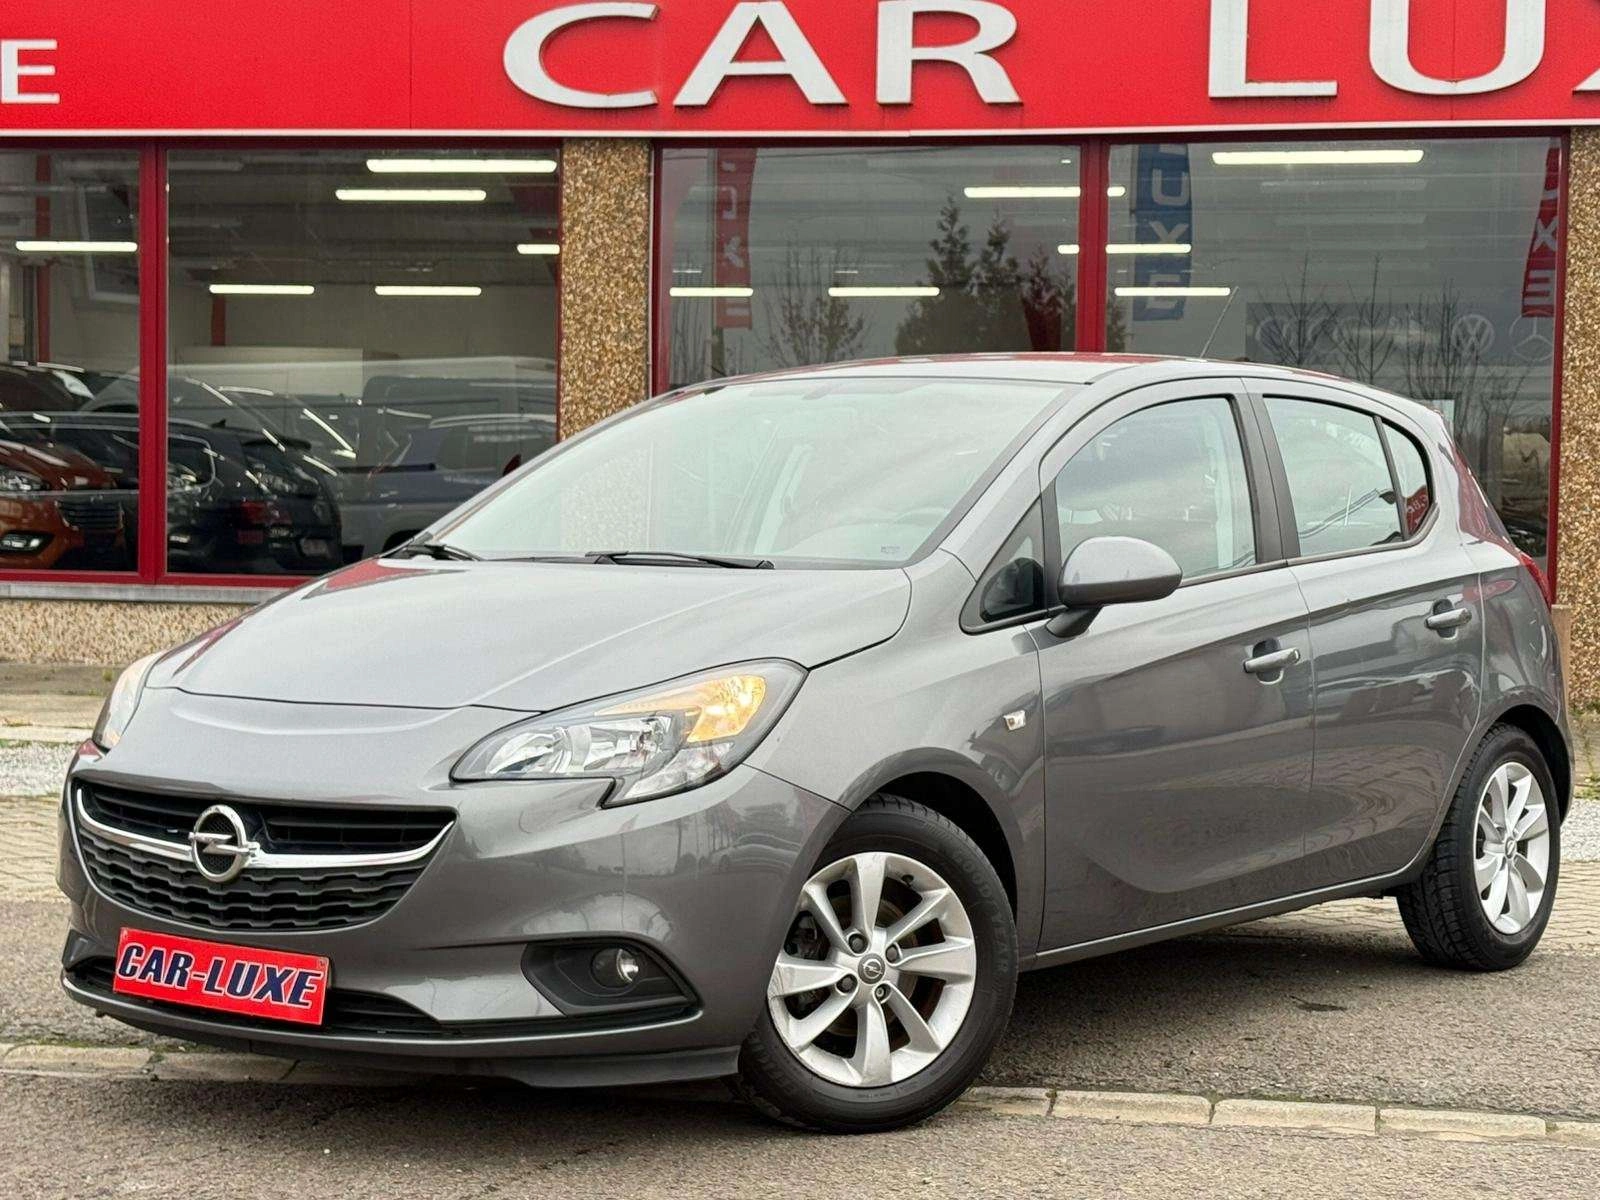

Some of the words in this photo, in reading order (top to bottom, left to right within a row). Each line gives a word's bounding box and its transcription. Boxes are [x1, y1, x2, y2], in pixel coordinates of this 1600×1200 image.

[503, 0, 1023, 109] CAR
[1208, 0, 1600, 98] LU
[115, 941, 323, 1009] CAR-LUXE
